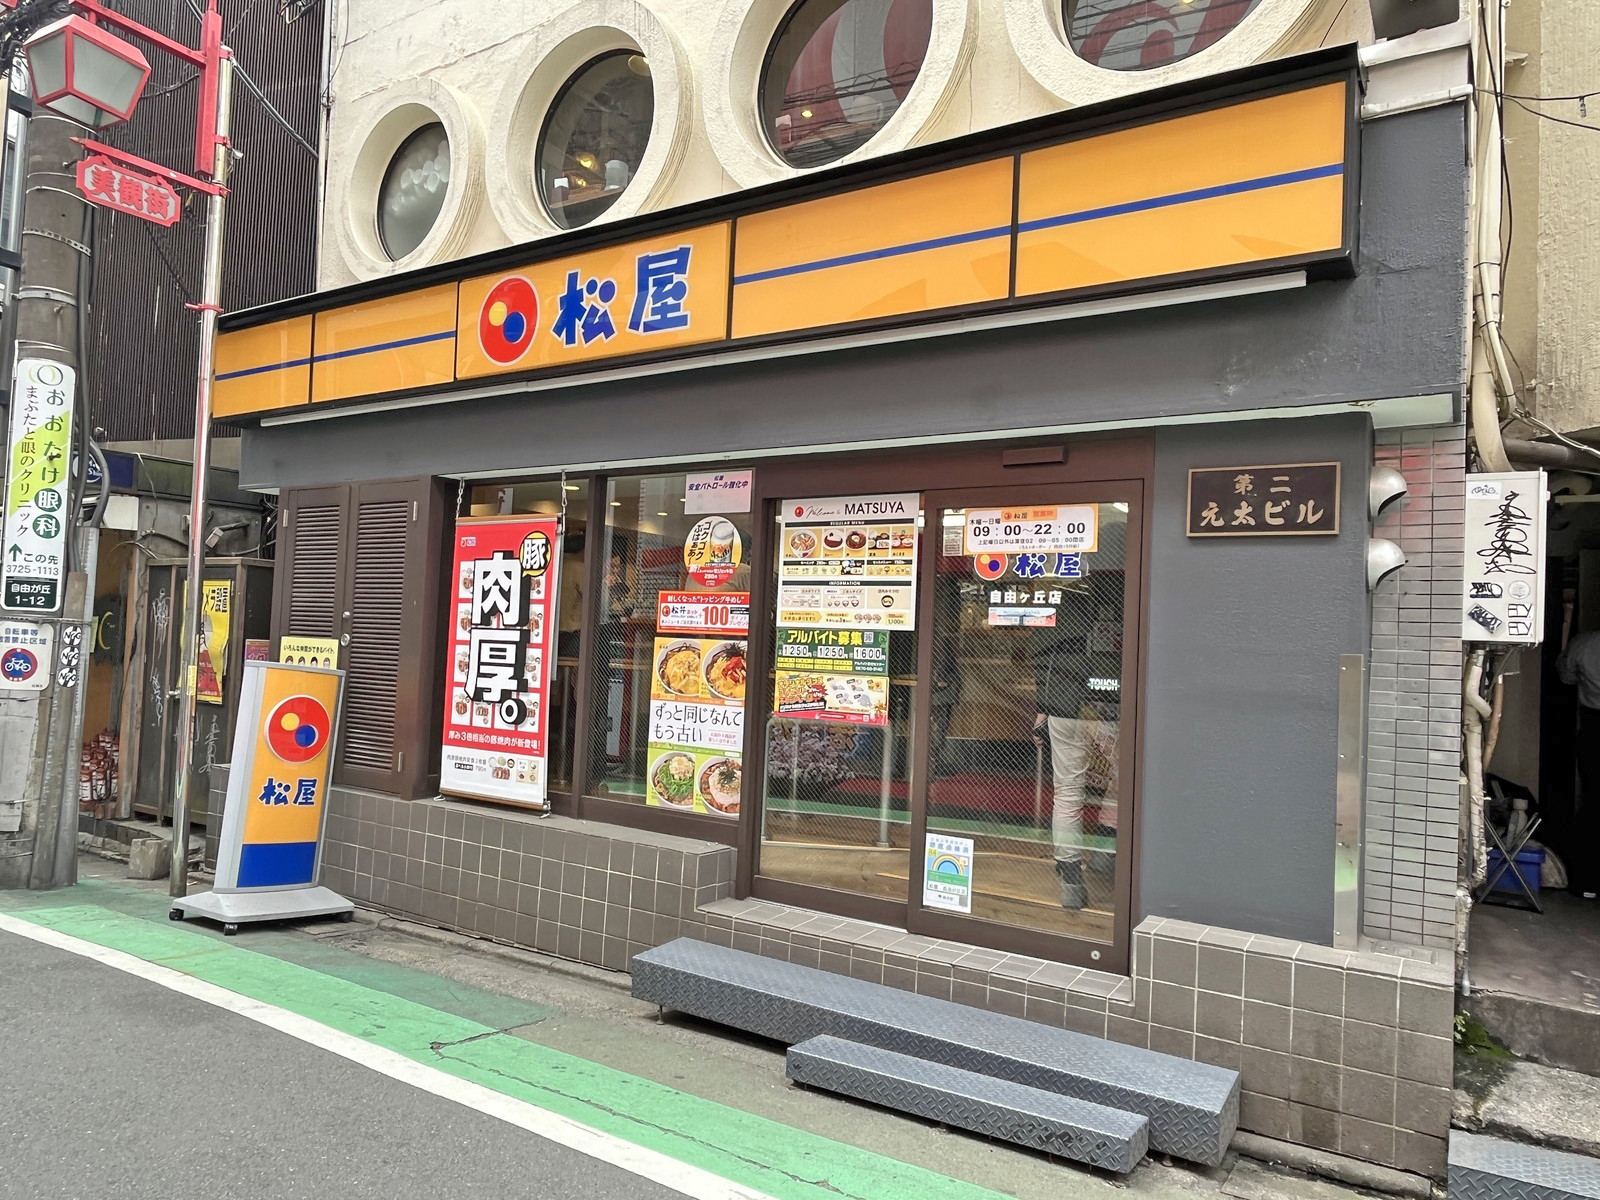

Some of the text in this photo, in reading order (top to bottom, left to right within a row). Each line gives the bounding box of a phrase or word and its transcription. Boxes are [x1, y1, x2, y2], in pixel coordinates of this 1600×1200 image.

[90, 166, 171, 219] 美観街
[550, 245, 694, 348] 松屋
[16, 385, 39, 537] まぶたと眼のクリニック
[1234, 474, 1292, 495] 第二
[844, 501, 905, 515] MATSUYA
[1200, 499, 1324, 528] 元太ビル
[696, 520, 713, 560] ゴクゴク
[23, 553, 59, 565] この先
[522, 537, 549, 570] 豚
[6, 563, 60, 576] 3725-1113
[1014, 552, 1082, 578] 松屋
[11, 583, 51, 594] 自由が丘
[990, 590, 1062, 604] 自由ヶ丘店
[14, 594, 46, 606] 1-12
[787, 630, 863, 646] アルバイト募集
[1088, 678, 1119, 691] TOUCH
[655, 702, 742, 727] ずっと同じなんて
[654, 723, 702, 743] もう古い
[259, 778, 317, 806] 松屋
